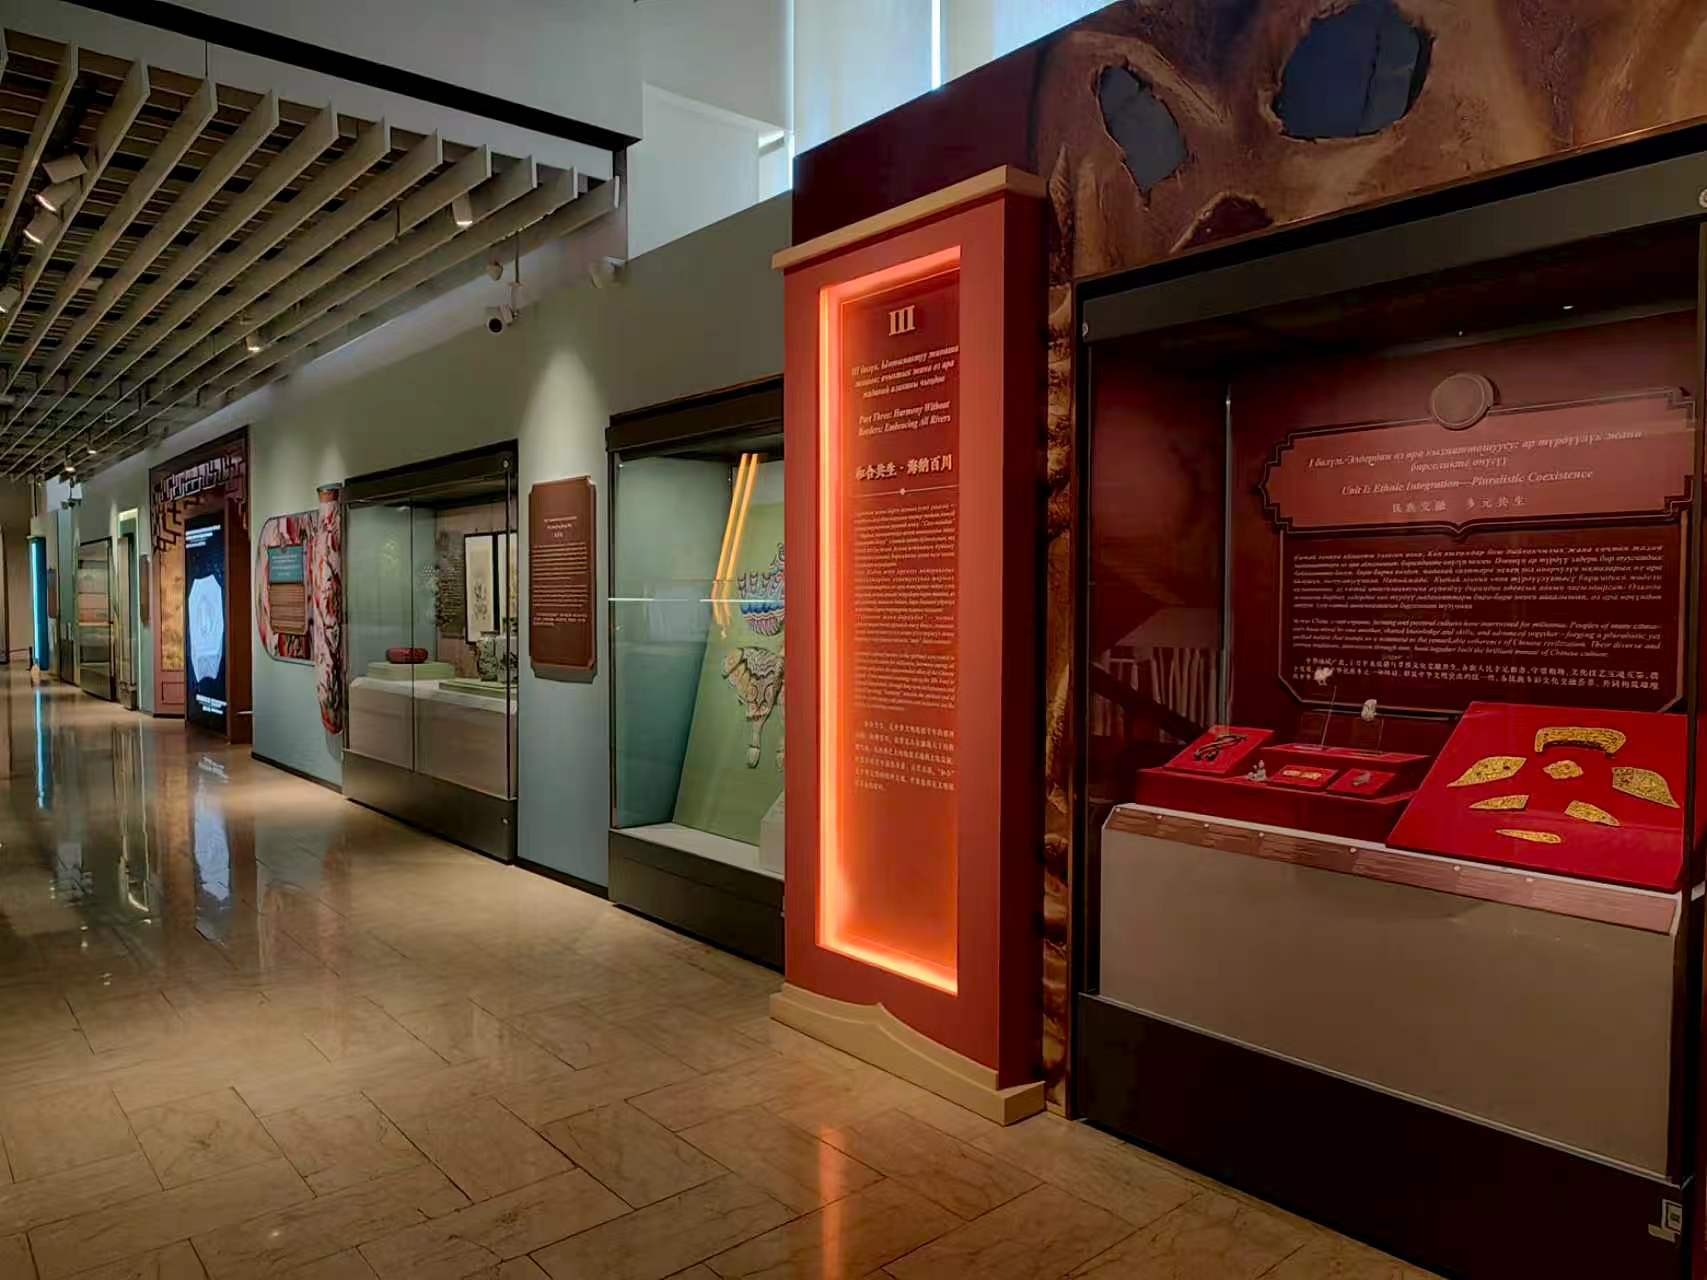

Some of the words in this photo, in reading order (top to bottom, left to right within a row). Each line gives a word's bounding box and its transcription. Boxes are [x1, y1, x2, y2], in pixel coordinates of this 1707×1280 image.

[888, 305, 916, 336] III
[893, 404, 923, 420] Harmony
[923, 401, 951, 414] Without
[884, 417, 918, 433] Embracing
[918, 414, 931, 427] All
[931, 413, 951, 426] Rivers
[1342, 486, 1361, 496] Unit
[1373, 481, 1403, 494] Ethnic
[1528, 469, 1593, 483] Coexistence
